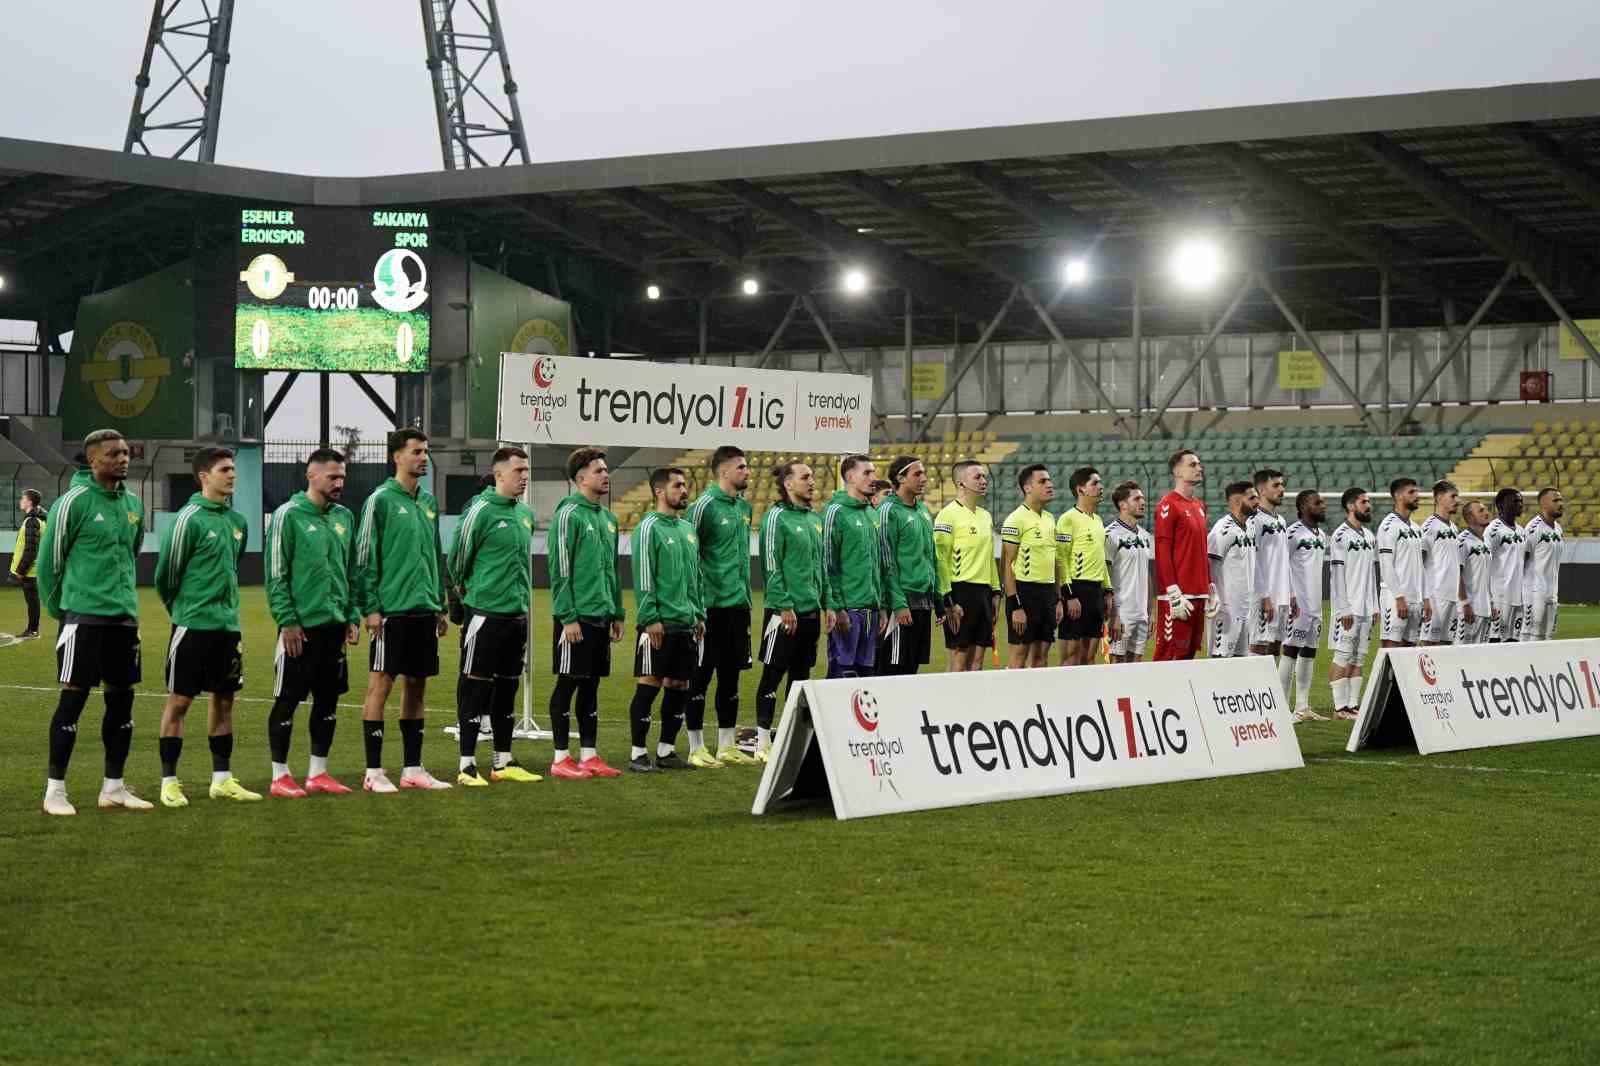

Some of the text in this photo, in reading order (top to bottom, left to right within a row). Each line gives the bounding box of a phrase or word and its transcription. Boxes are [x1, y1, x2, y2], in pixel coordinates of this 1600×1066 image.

[241, 210, 294, 225] ESENLER
[373, 212, 428, 227] SAKARYA
[241, 229, 304, 245] EROKSPOR
[395, 233, 428, 248] SPOR
[308, 286, 358, 310] 00:00
[252, 319, 269, 360] 0
[396, 322, 414, 363] 0
[519, 391, 567, 409] trendyol
[576, 377, 725, 435] trendyol
[808, 391, 860, 413] trendyol
[814, 414, 852, 431] yemek
[1212, 687, 1277, 717] trendyol
[1420, 689, 1455, 707] trendyol
[1461, 661, 1584, 723] trendyol
[920, 699, 1117, 779] trendyol
[1230, 719, 1278, 747] yemek
[849, 737, 904, 759] trendyol
